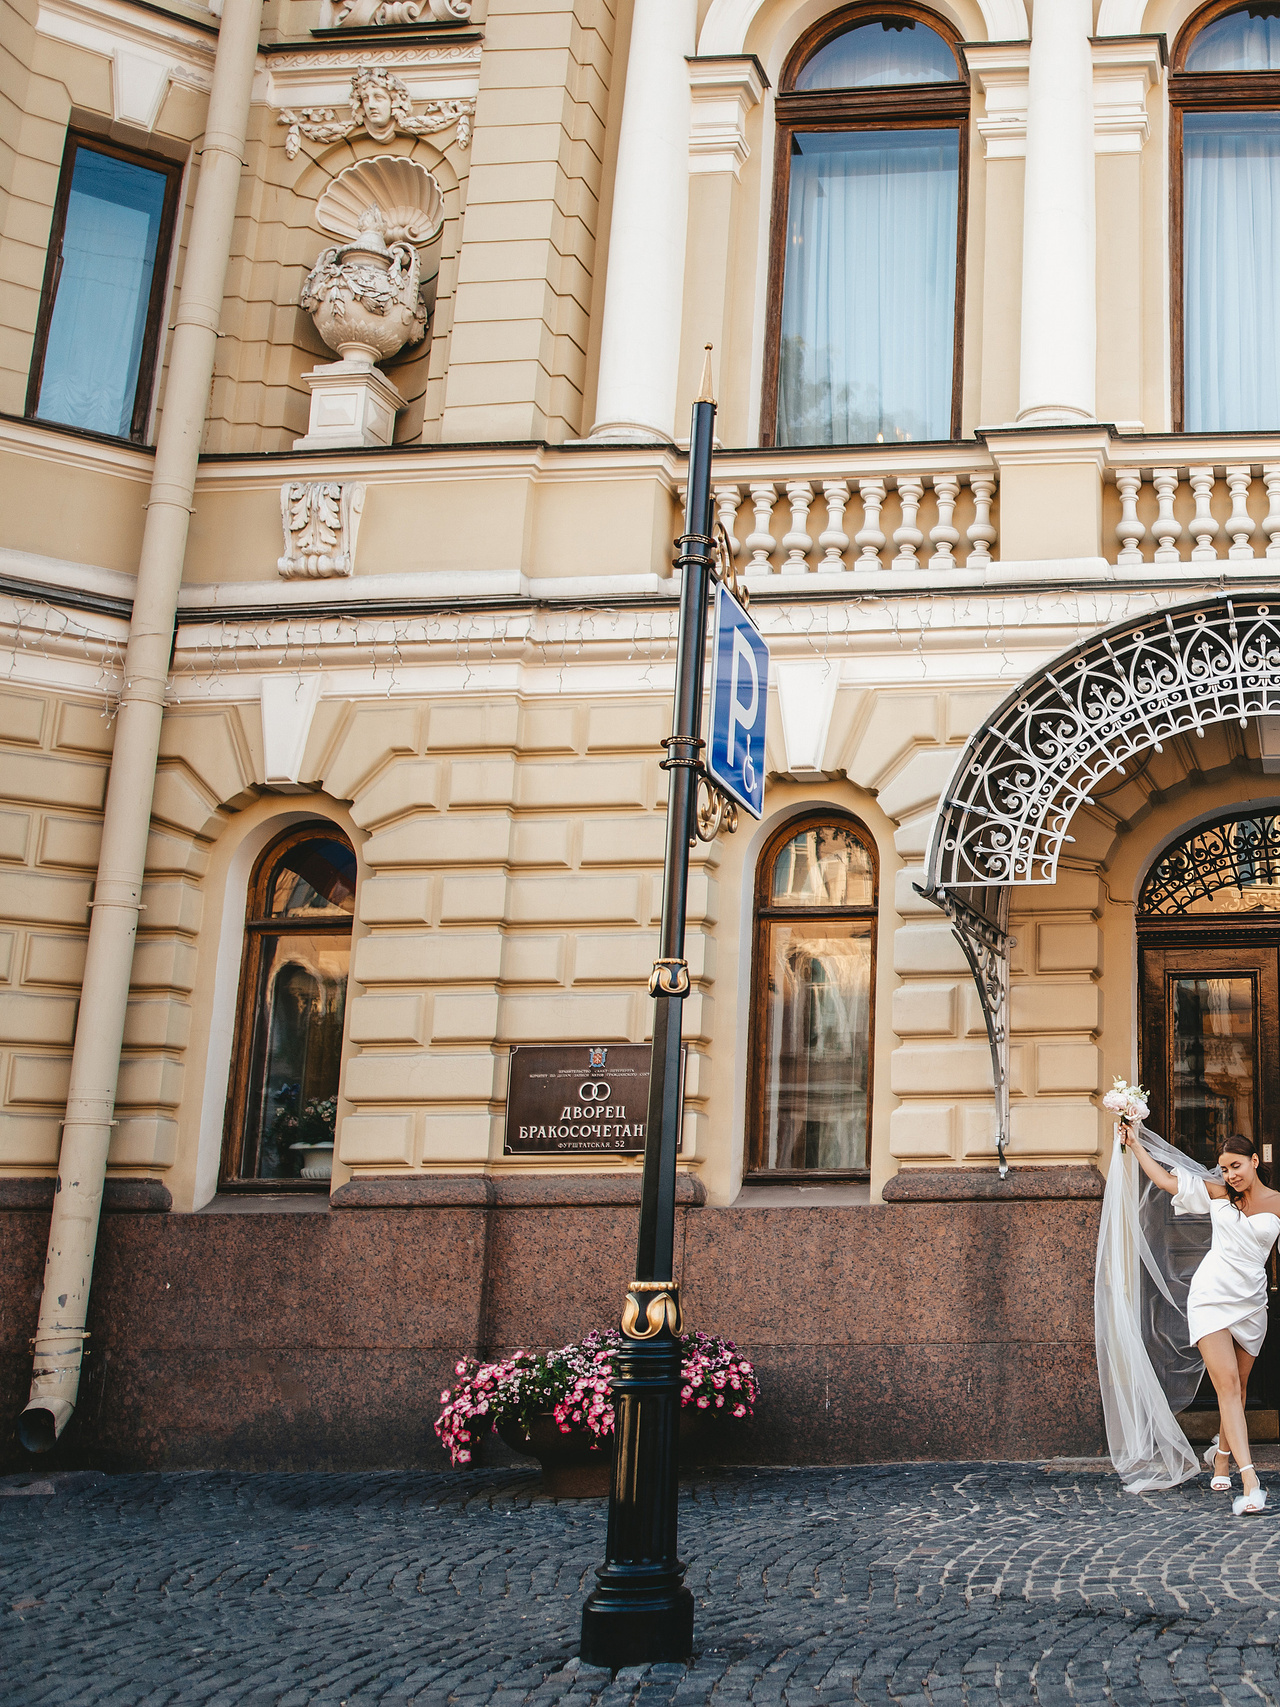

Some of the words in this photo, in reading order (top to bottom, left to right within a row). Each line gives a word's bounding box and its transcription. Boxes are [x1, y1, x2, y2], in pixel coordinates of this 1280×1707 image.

[726, 625, 759, 768] P
[560, 1105, 627, 1121] ДВОРЕЦ
[518, 1124, 647, 1139] БРАКОСОЧЕТАН
[614, 1140, 625, 1148] 52
